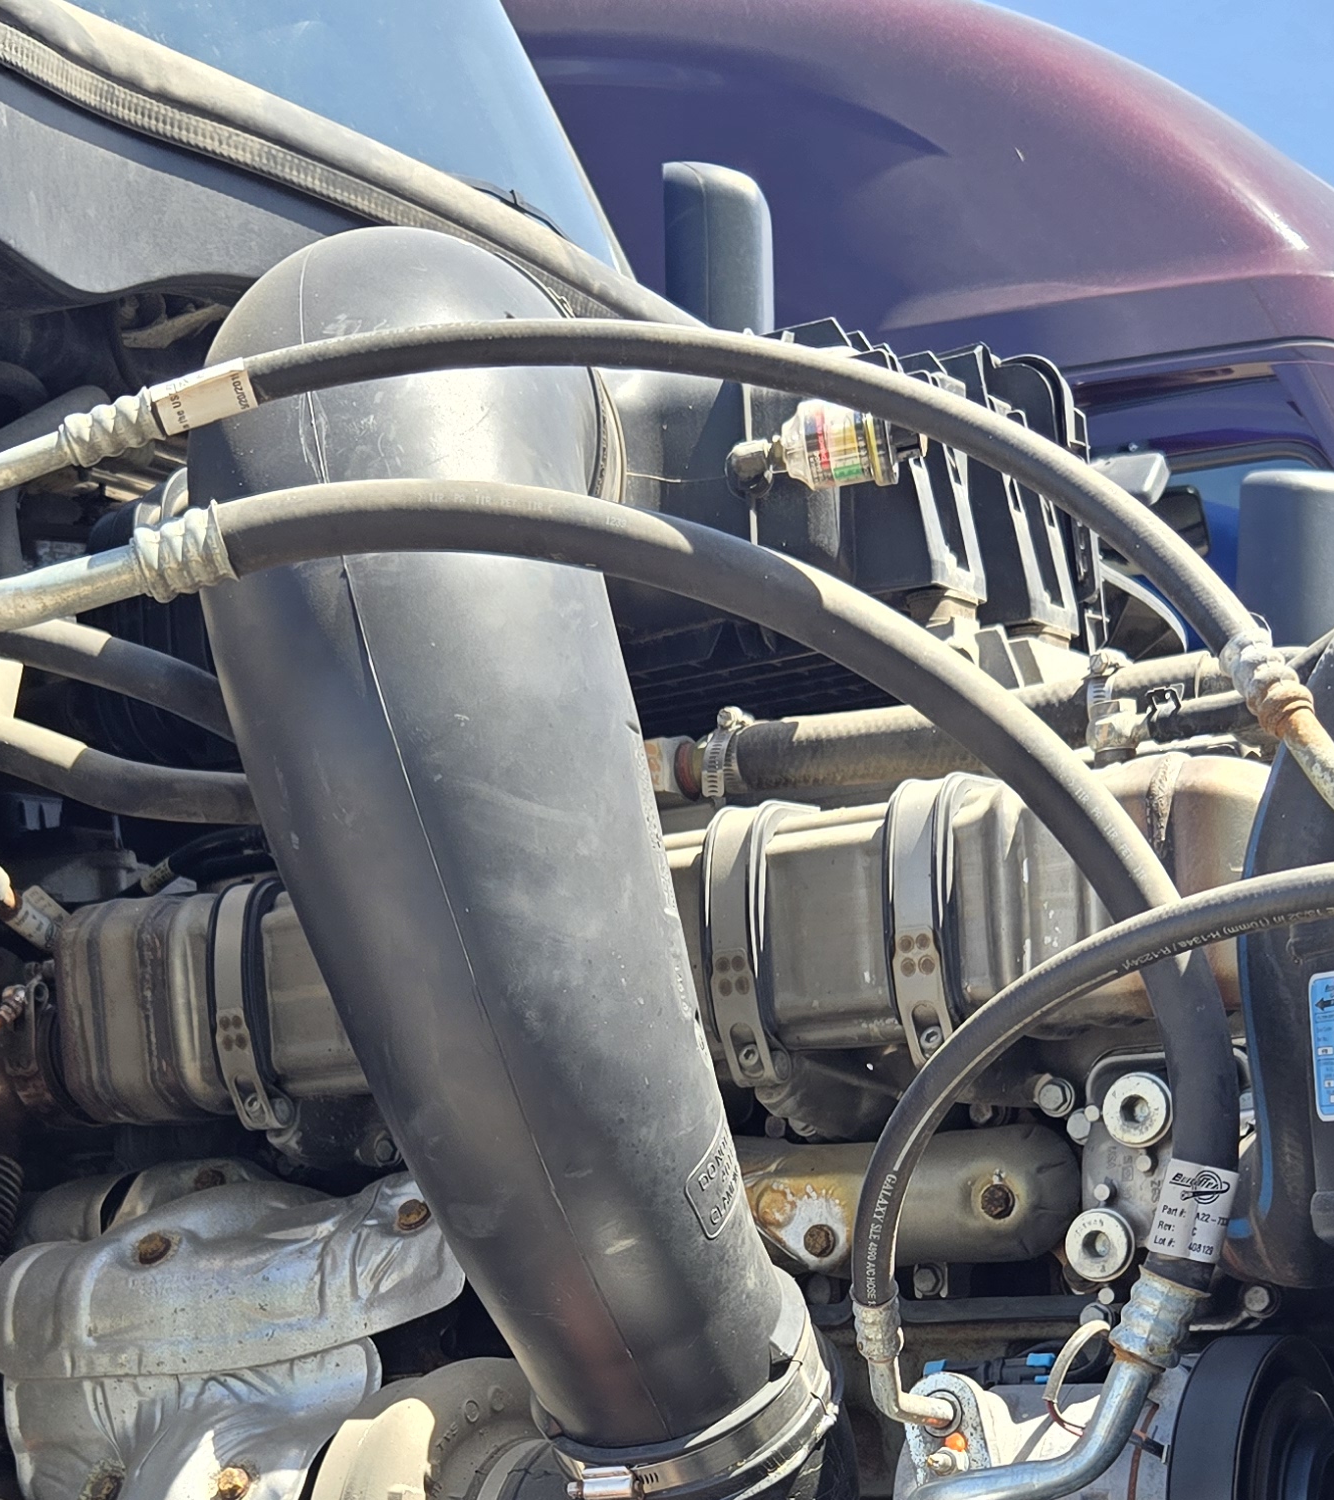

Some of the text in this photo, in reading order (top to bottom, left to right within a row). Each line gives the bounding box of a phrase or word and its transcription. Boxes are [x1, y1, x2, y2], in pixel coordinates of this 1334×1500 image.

[873, 1174, 897, 1222] GALAXY
[1162, 1204, 1177, 1216] Part
[869, 1223, 882, 1240] SLE
[1157, 1220, 1175, 1232] Rev:
[1153, 1235, 1165, 1245] Lot
[867, 1276, 877, 1300] HOSE
